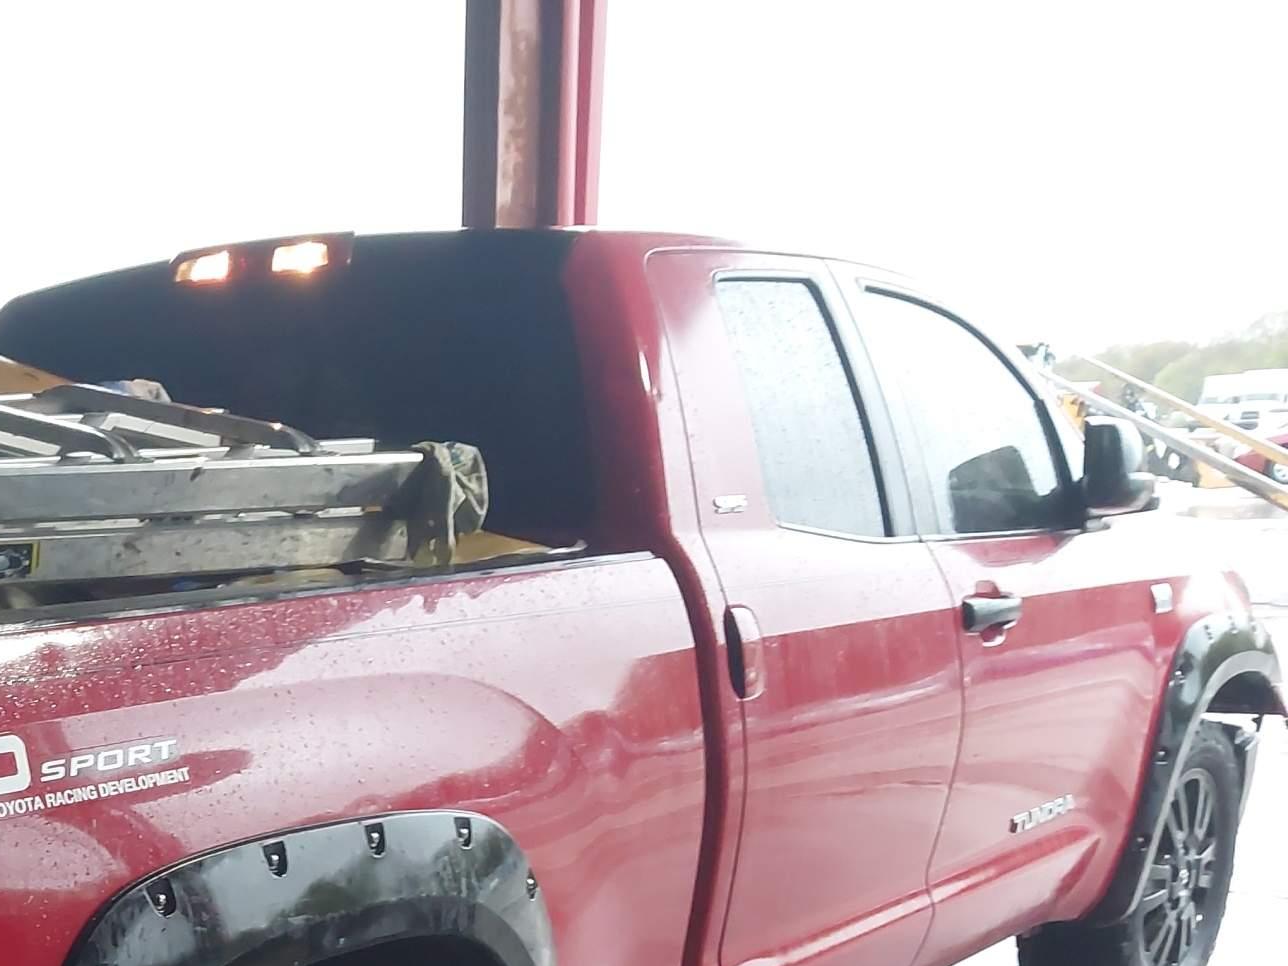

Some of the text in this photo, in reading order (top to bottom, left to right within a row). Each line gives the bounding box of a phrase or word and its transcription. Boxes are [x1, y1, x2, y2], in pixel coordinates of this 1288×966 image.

[40, 739, 177, 782] SPORT
[46, 788, 98, 808] RACING
[99, 767, 191, 797] DEVELOPMENT
